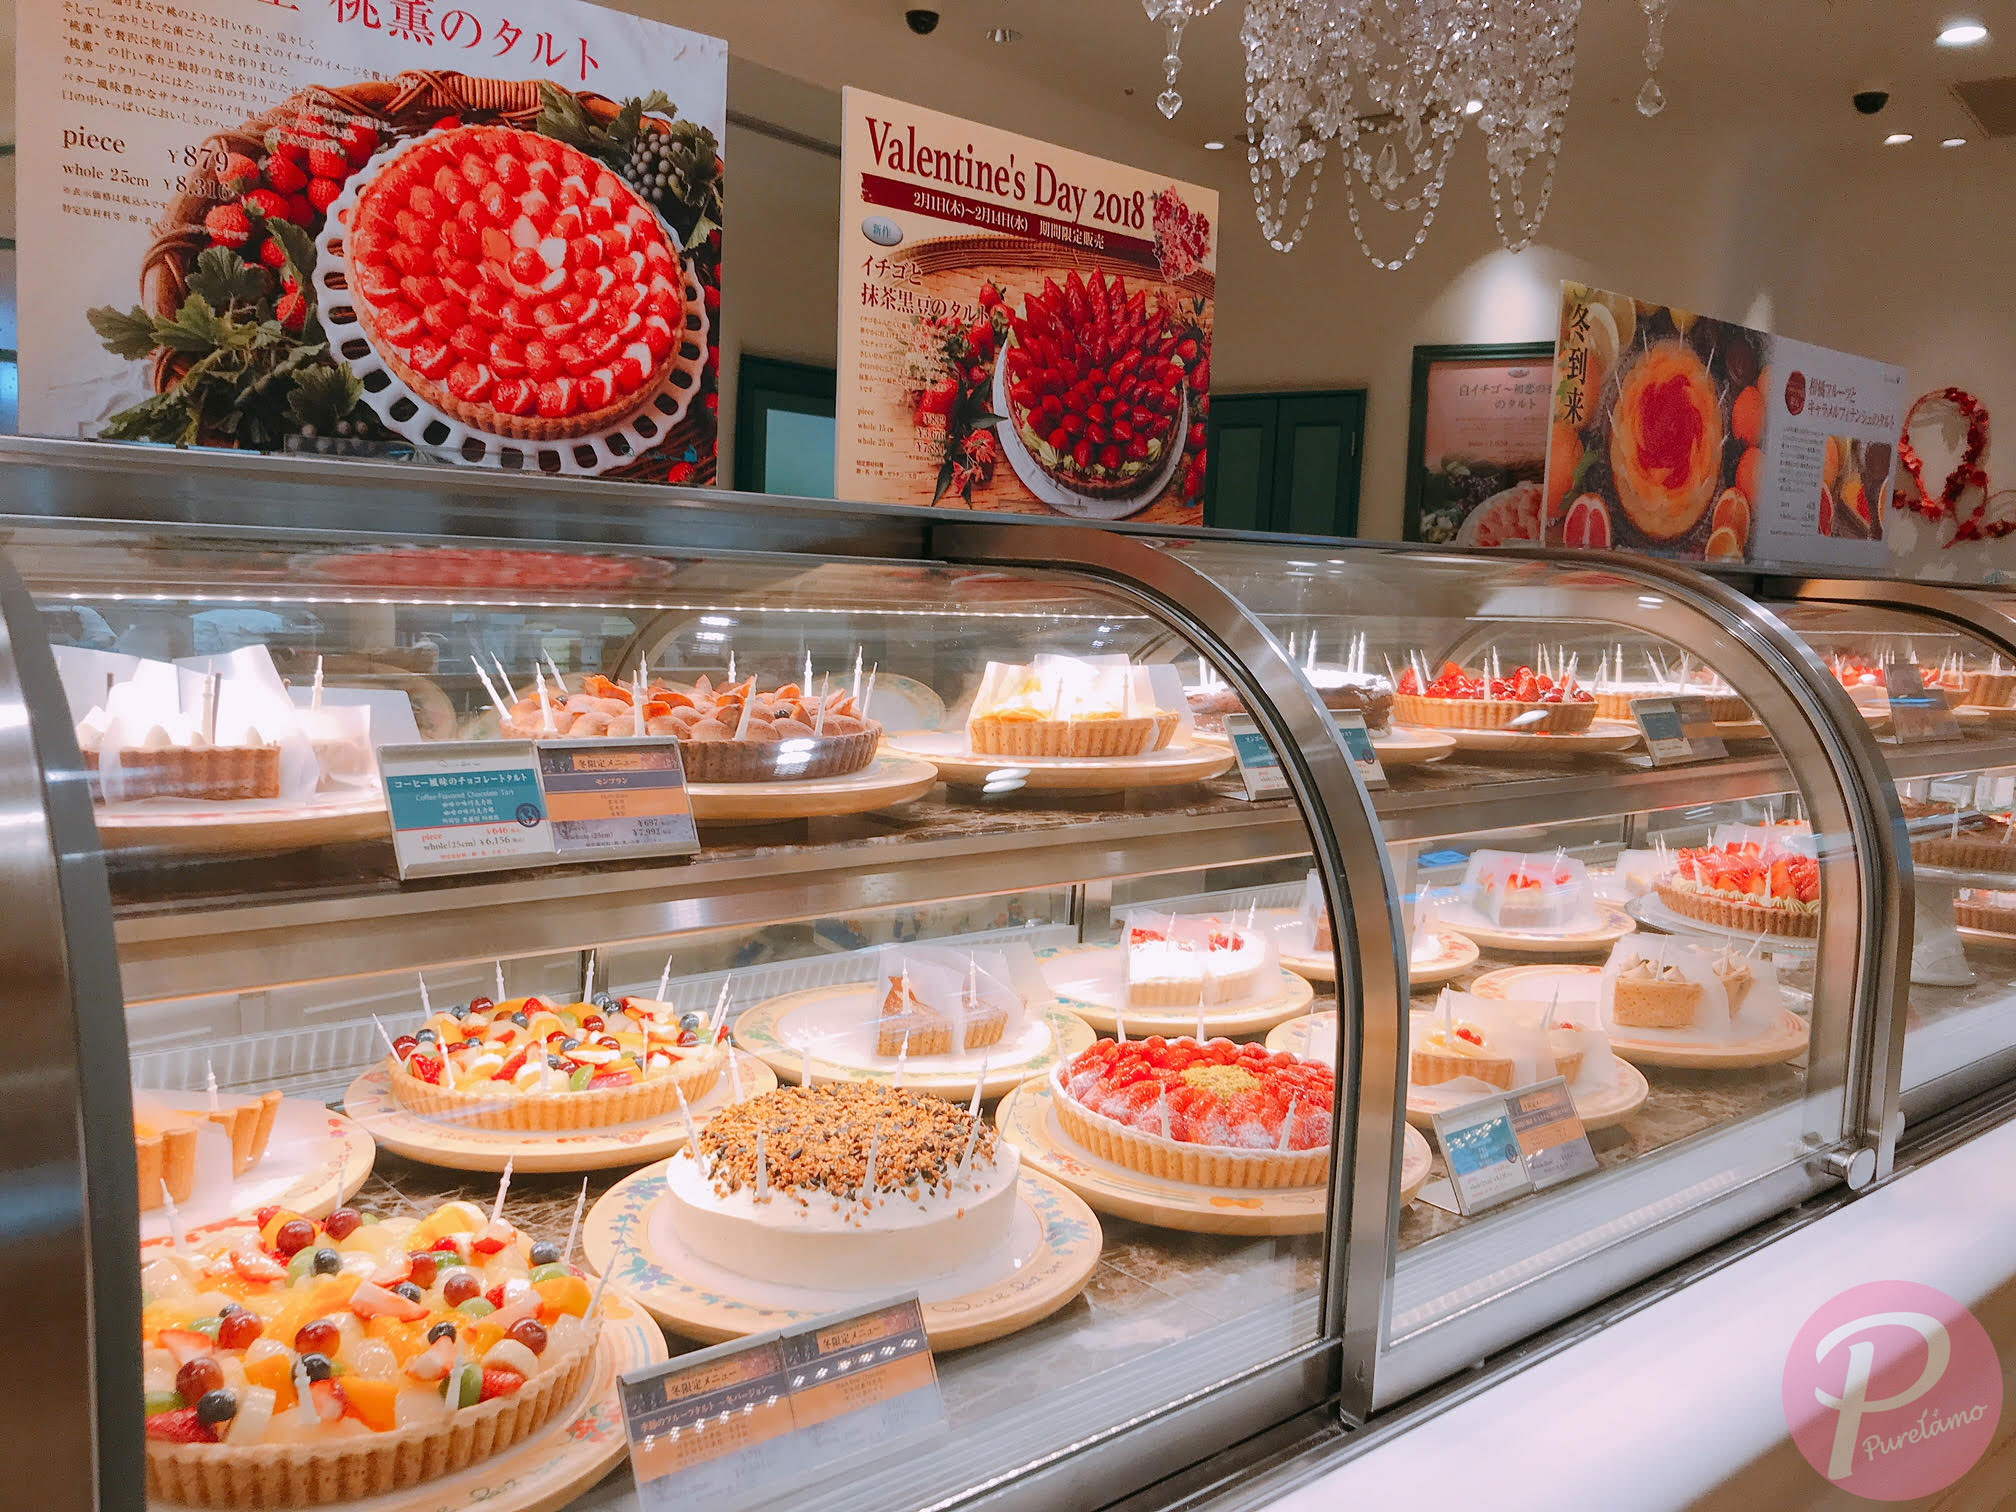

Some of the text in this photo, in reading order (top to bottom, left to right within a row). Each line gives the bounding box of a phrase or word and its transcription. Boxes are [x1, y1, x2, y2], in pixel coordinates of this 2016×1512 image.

[63, 126, 126, 154] piece
[62, 163, 150, 188] whole 25cm
[865, 116, 1146, 230] Valentine's Day 2018
[1039, 220, 1106, 251] 期間限定販売
[862, 255, 924, 287] イチゴと
[861, 282, 991, 326] 抹茶黒豆のタルト
[1563, 303, 1591, 424] 冬到来
